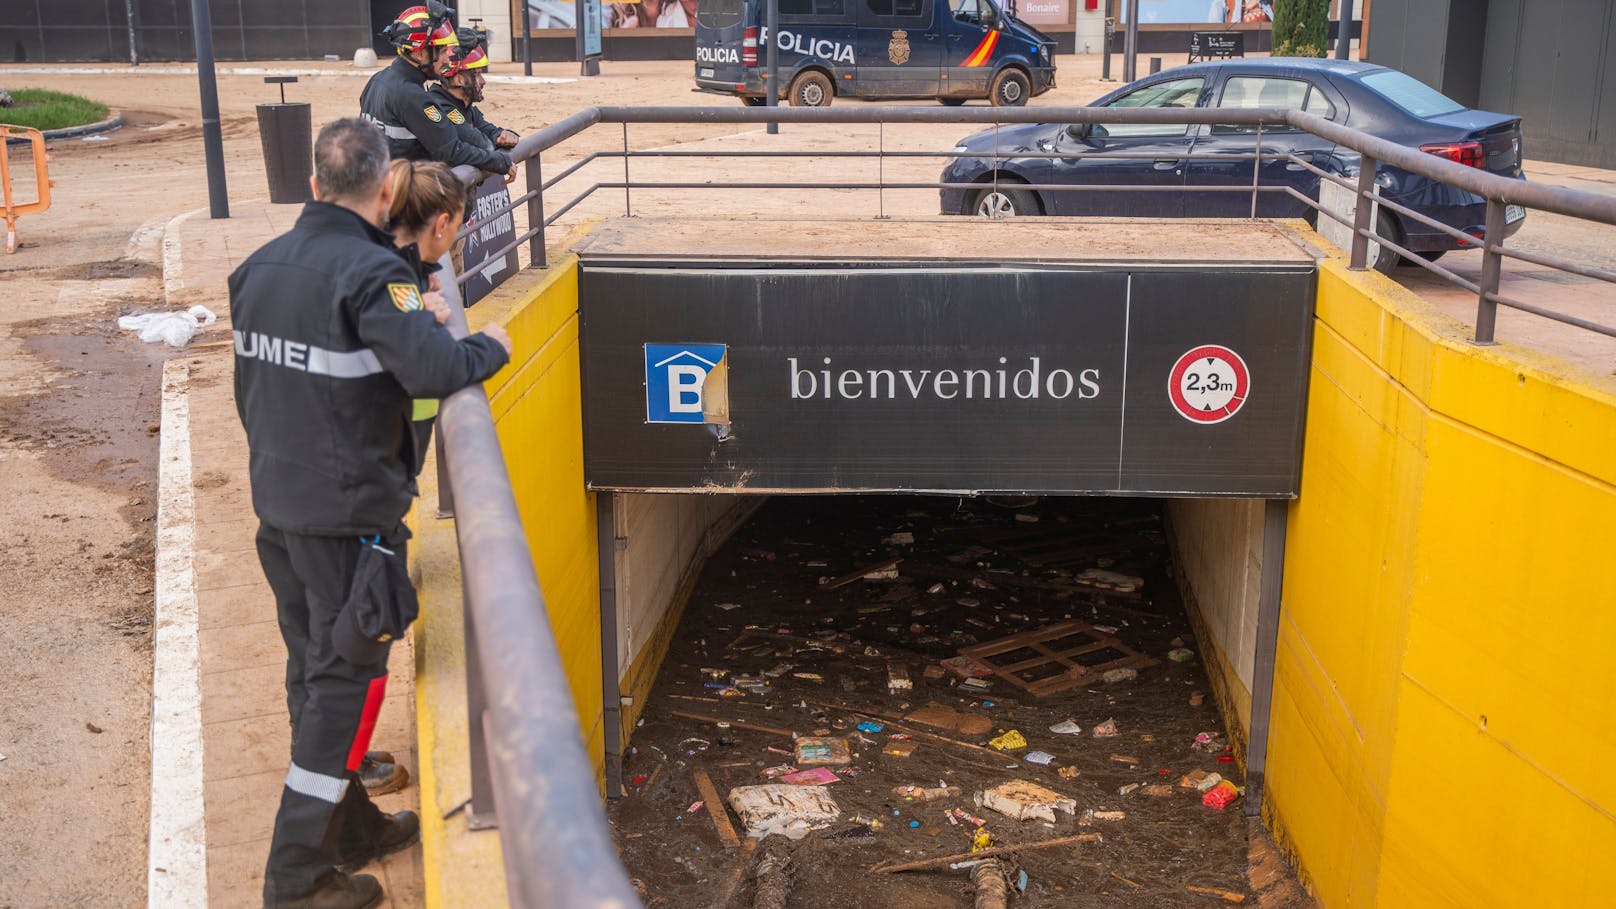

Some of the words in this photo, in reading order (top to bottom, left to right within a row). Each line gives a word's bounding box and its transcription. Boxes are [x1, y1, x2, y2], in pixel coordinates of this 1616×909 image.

[696, 47, 739, 63] POLICIA
[759, 26, 856, 64] POLICIA
[477, 189, 509, 220] FOSTER'S
[233, 329, 307, 371] UME
[788, 356, 1101, 399] bienvenidos
[1186, 372, 1233, 394] 2,3m
